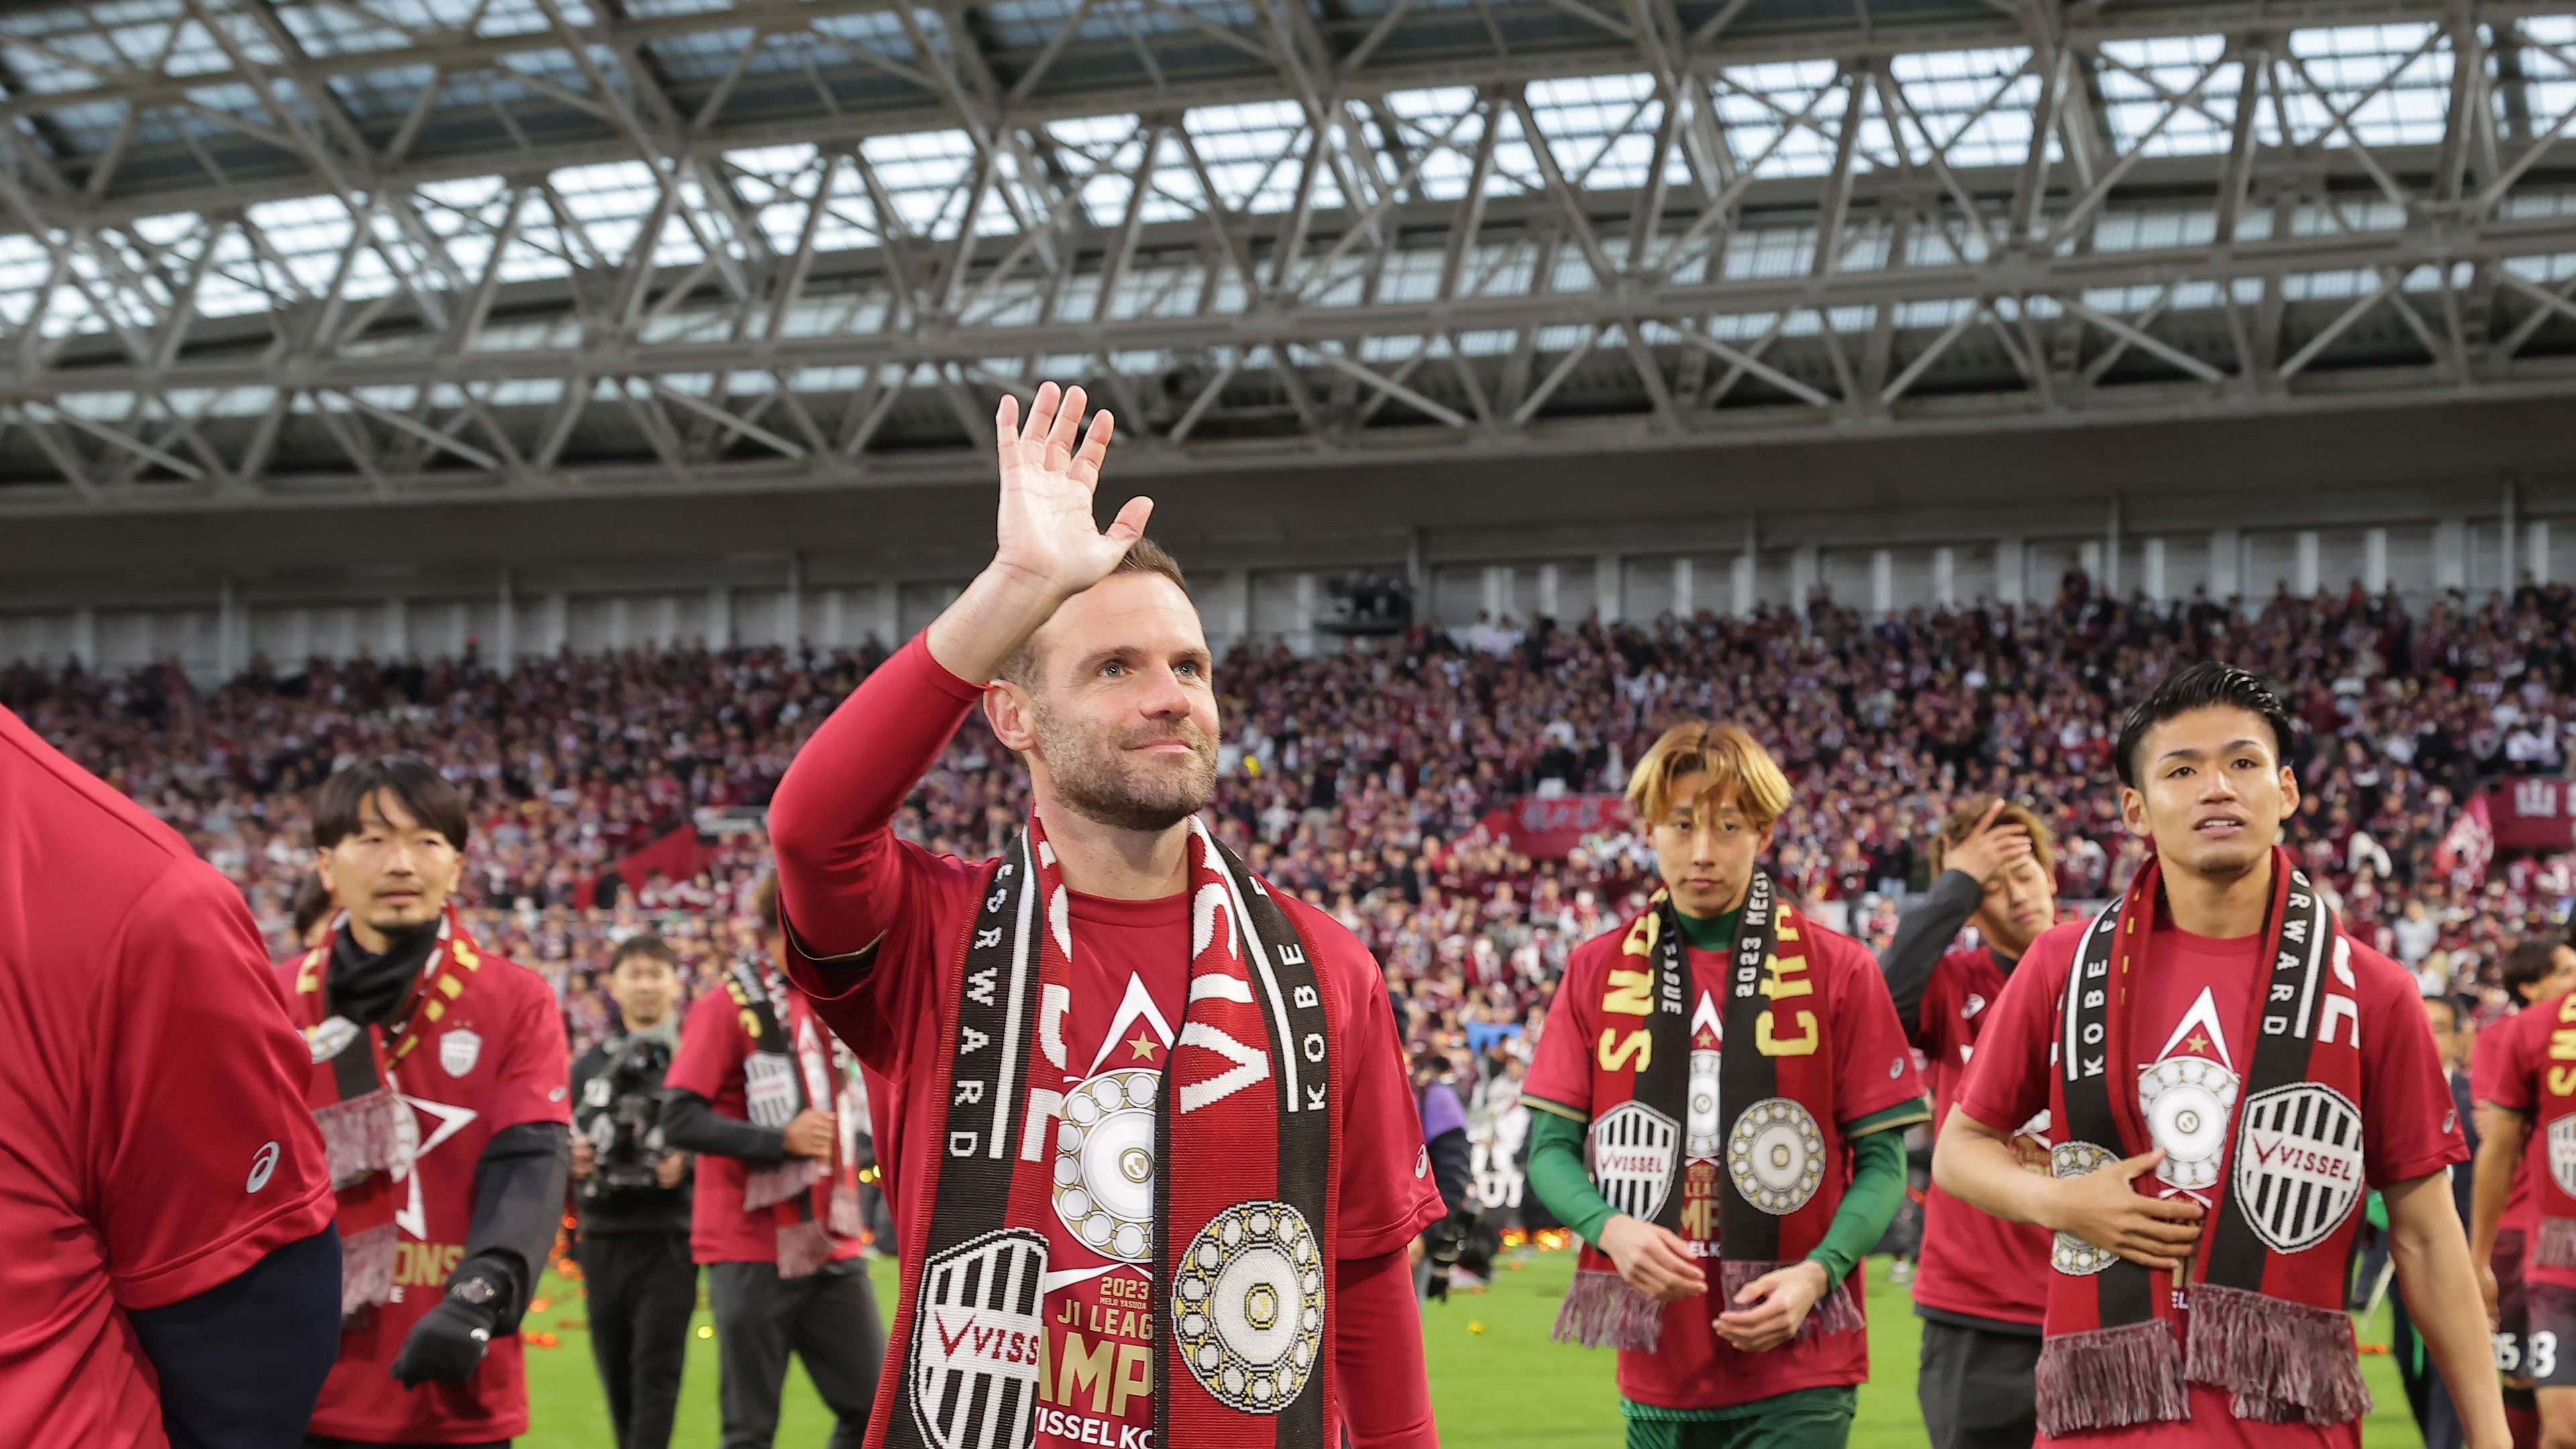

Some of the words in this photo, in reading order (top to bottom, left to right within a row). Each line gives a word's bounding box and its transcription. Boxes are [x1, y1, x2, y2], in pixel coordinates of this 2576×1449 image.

[1735, 936, 1762, 998] 2023
[1276, 943, 1326, 1111] KOBE
[2083, 959, 2108, 1077] KOBE
[1613, 1155, 1664, 1173] VISSEL
[2281, 1146, 2351, 1181] VISSEL
[1099, 1276, 1149, 1300] 2023
[1099, 1297, 1119, 1307] MEIJI
[1120, 1299, 1147, 1310] YASUDA
[1056, 1298, 1081, 1327] J1
[1035, 1406, 1116, 1448] ISSEL
